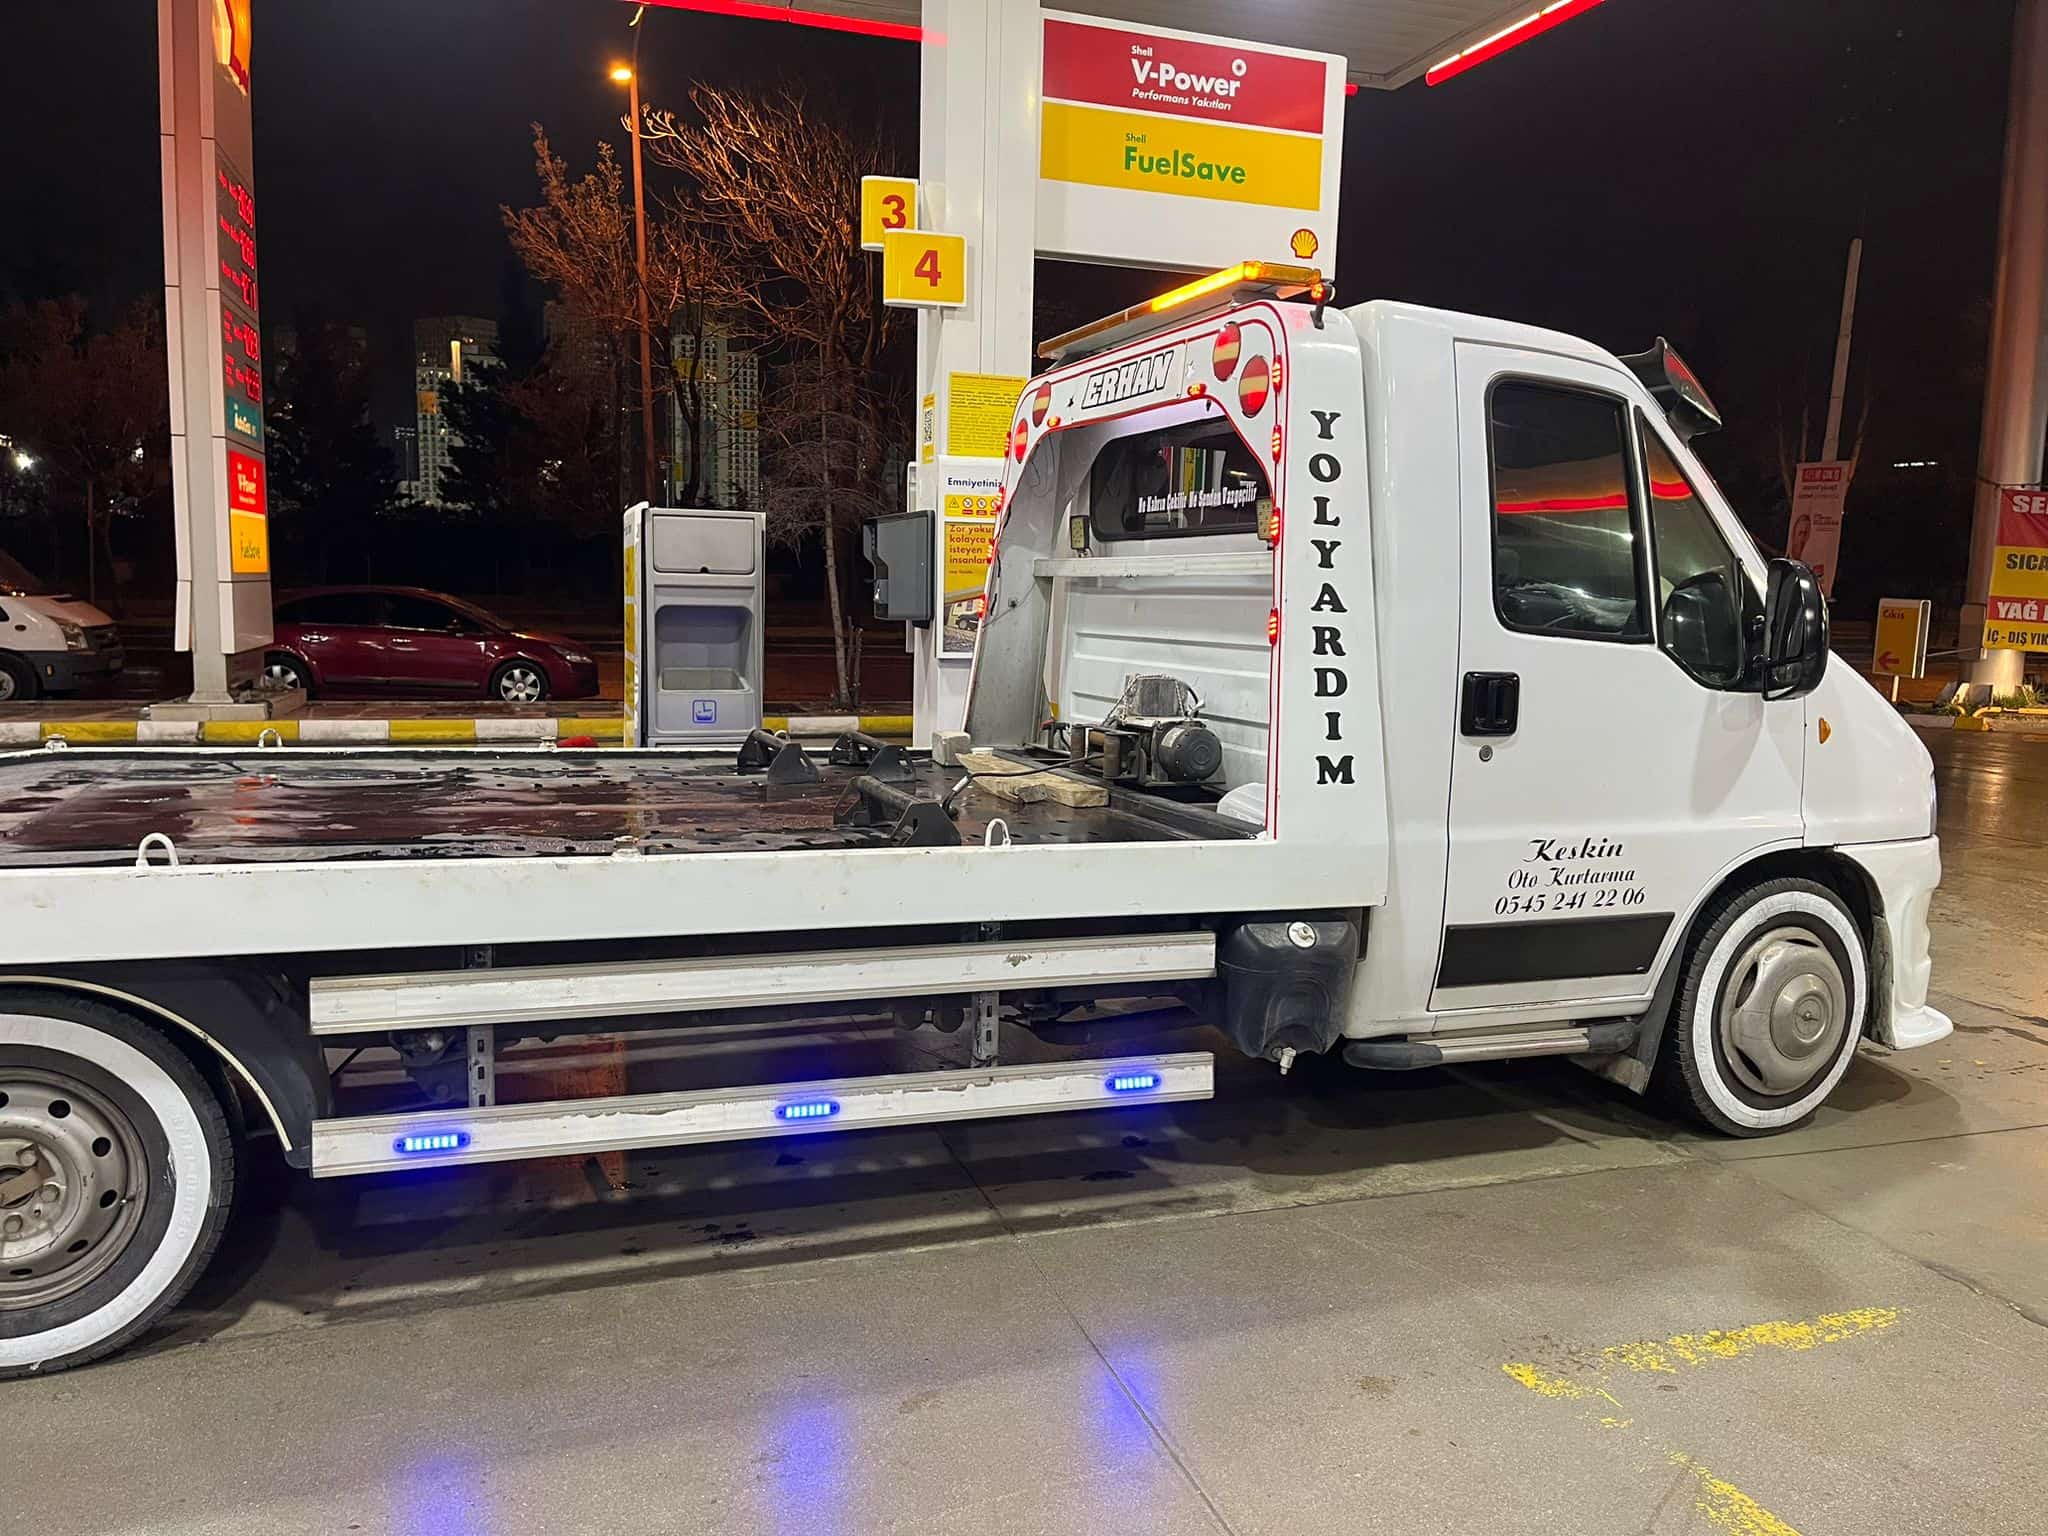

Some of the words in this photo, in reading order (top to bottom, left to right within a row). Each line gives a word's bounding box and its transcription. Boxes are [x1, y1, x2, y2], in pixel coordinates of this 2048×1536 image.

[1131, 45, 1153, 57] Shell
[1131, 58, 1241, 97] V-Power
[1132, 88, 1189, 105] Performans
[1125, 132, 1147, 144] Shell
[1124, 146, 1246, 184] FuelSave
[881, 194, 907, 229] 3
[914, 249, 942, 287] 4
[1081, 350, 1175, 410] ERHAN
[2012, 495, 2048, 514] SE
[1997, 600, 2038, 620] YAĞ
[2007, 631, 2028, 646] DIŞ
[1522, 837, 1624, 862] Keskin
[1508, 869, 1538, 889] Oto
[1544, 867, 1636, 887] Kurtarma
[1495, 894, 1546, 914] 0545
[1552, 891, 1587, 910] 241
[1592, 889, 1618, 907] 22
[1622, 887, 1647, 905] 06
